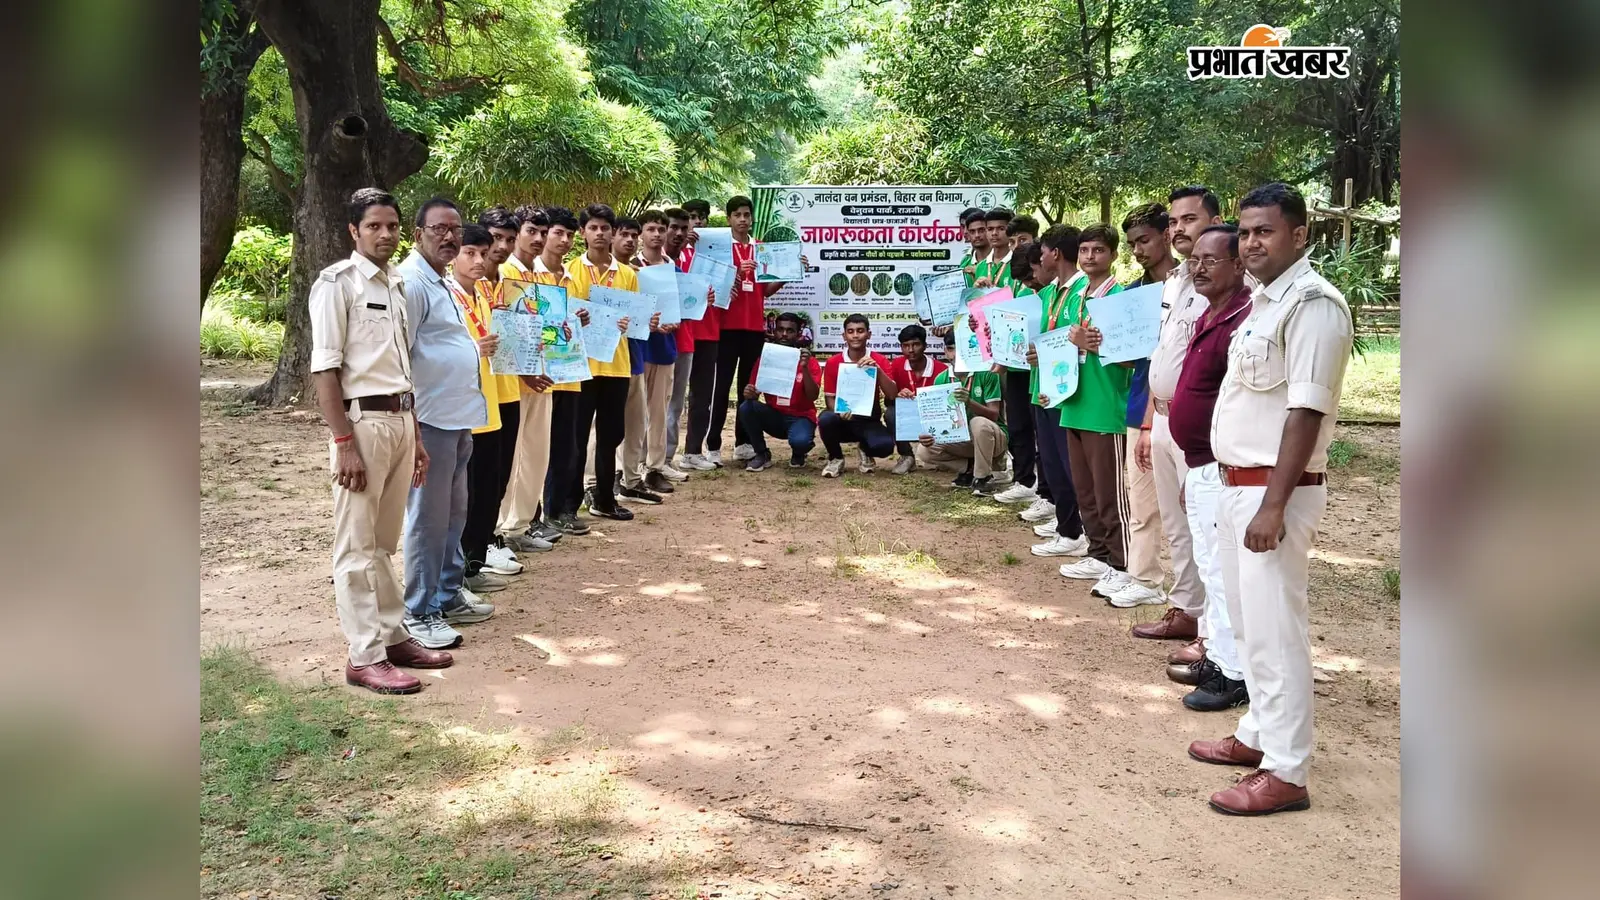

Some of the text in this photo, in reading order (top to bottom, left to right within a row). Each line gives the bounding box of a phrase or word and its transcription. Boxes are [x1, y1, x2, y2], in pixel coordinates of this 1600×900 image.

[814, 190, 963, 204] नालंदा वन प्रमंडल, बिहार वन विभाग
[898, 206, 924, 215] राजगीर
[909, 217, 920, 226] हेतु
[800, 226, 894, 244] जागरूकता
